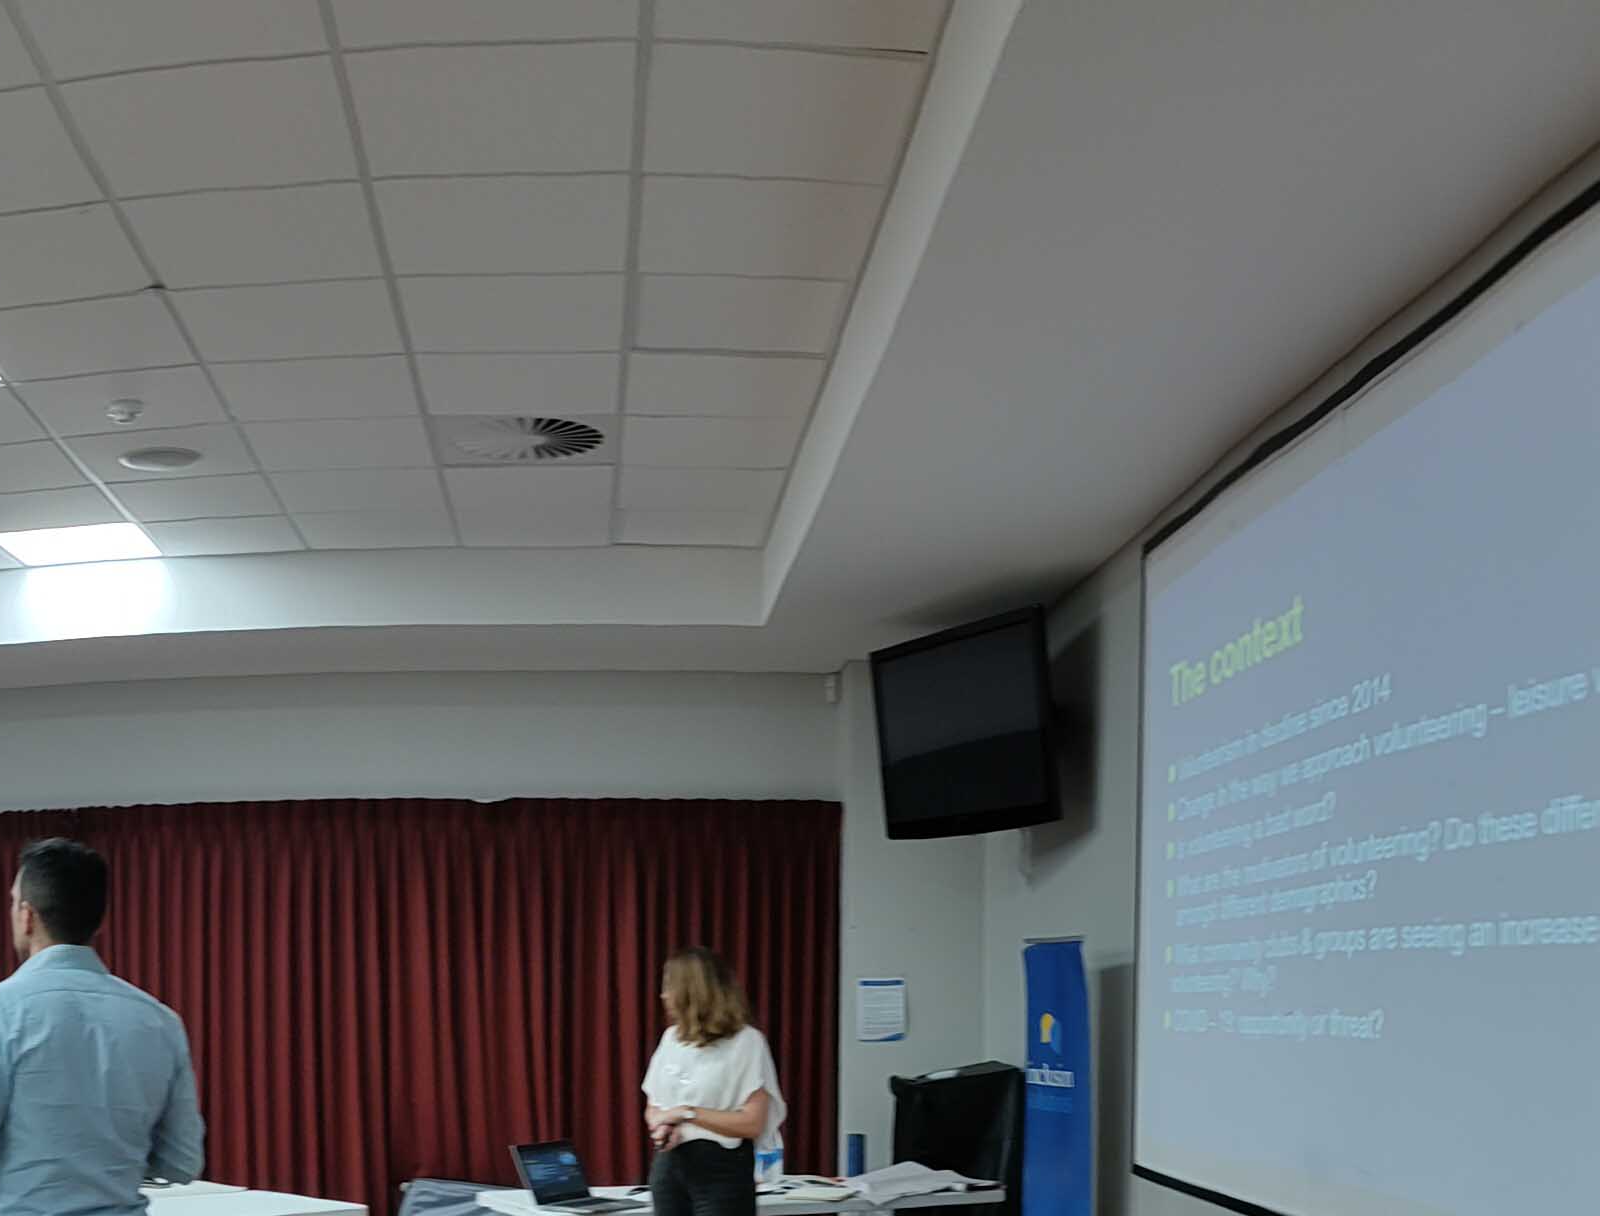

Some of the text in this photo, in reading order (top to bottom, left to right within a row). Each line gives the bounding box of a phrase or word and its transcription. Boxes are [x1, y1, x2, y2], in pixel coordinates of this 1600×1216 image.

[1169, 596, 1304, 706] The context
[1351, 672, 1392, 715] 2014
[1372, 703, 1488, 758] volunteering
[1506, 670, 1589, 720] leisure
[1328, 819, 1443, 866] volunteering?
[1444, 816, 1477, 851] Do
[1477, 810, 1539, 845] these
[1368, 926, 1398, 951] are
[1400, 916, 1467, 957] seeing
[1467, 920, 1497, 948] an
